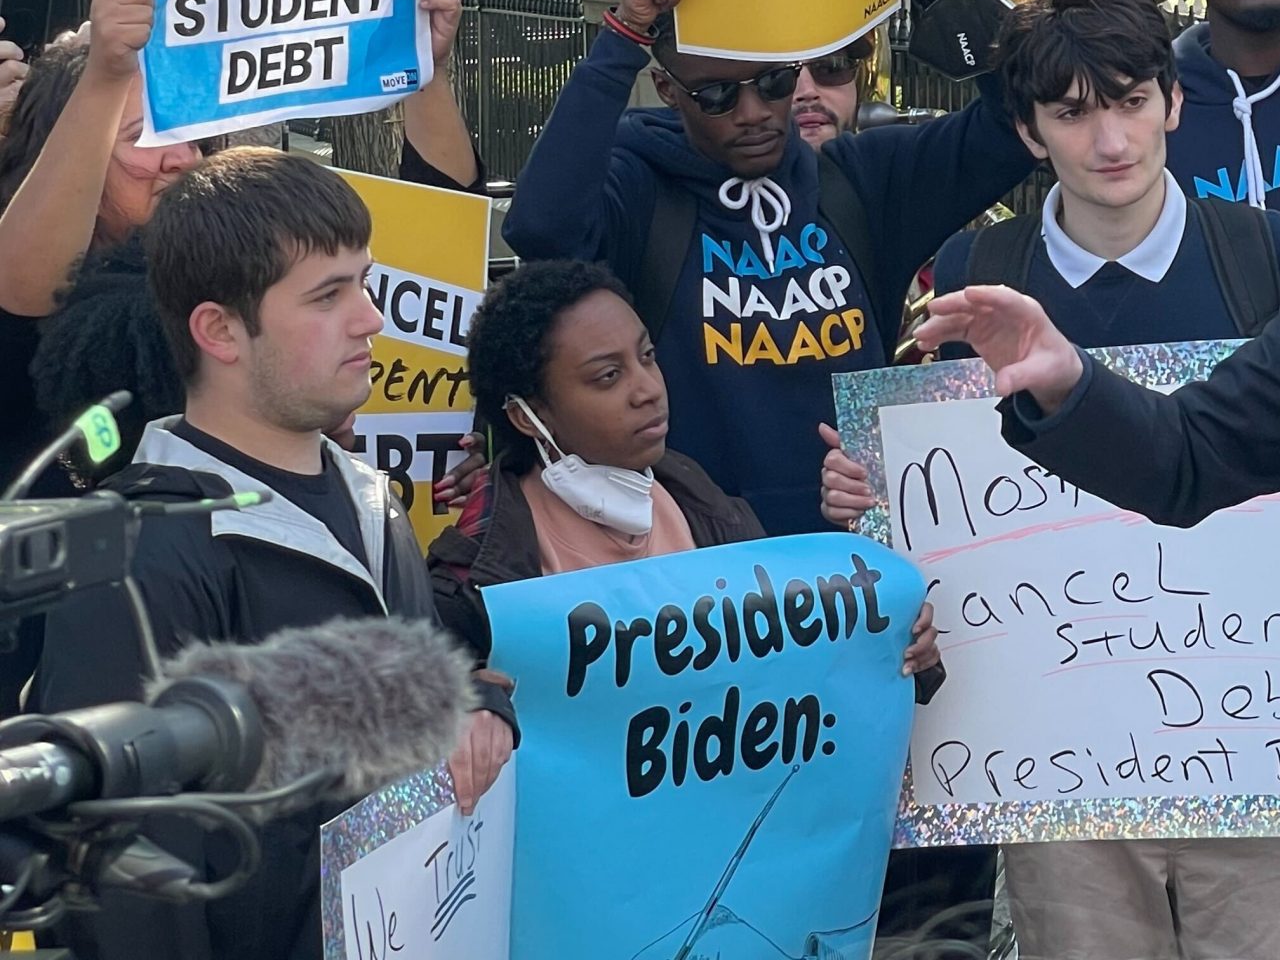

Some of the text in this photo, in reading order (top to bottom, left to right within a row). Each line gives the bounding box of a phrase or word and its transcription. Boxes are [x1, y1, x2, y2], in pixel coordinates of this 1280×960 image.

[227, 36, 344, 95] DEBT
[957, 32, 976, 66] NAACP
[365, 272, 468, 348] NCEL
[703, 265, 851, 321] NAACP
[703, 308, 865, 366] NAACP
[566, 553, 890, 697] President
[625, 686, 837, 798] Biden:
[930, 732, 1238, 798] President
[351, 811, 484, 960] We Trust
